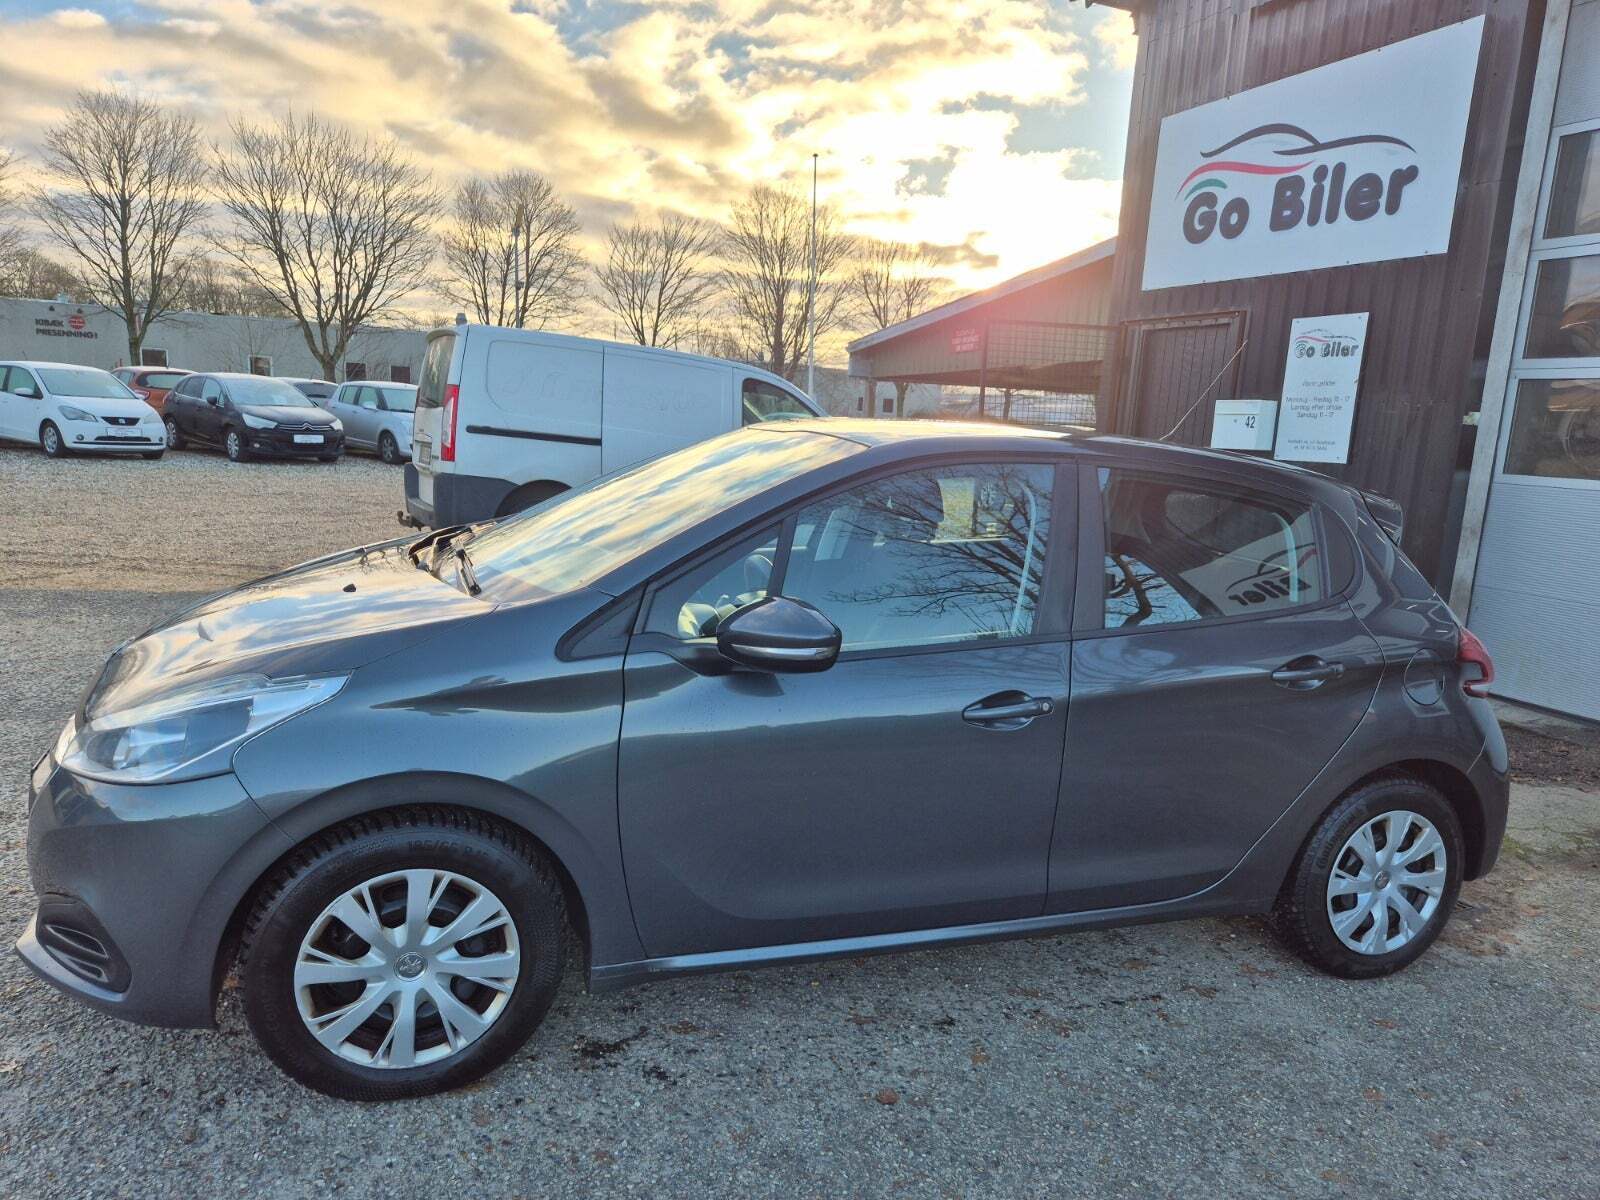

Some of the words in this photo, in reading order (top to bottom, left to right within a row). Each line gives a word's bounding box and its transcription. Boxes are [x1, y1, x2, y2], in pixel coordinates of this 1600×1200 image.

[1182, 191, 1250, 245] Go
[1269, 161, 1420, 233] Biler
[1295, 342, 1315, 358] Go
[1320, 341, 1359, 358] Biler
[1245, 416, 1256, 429] 42
